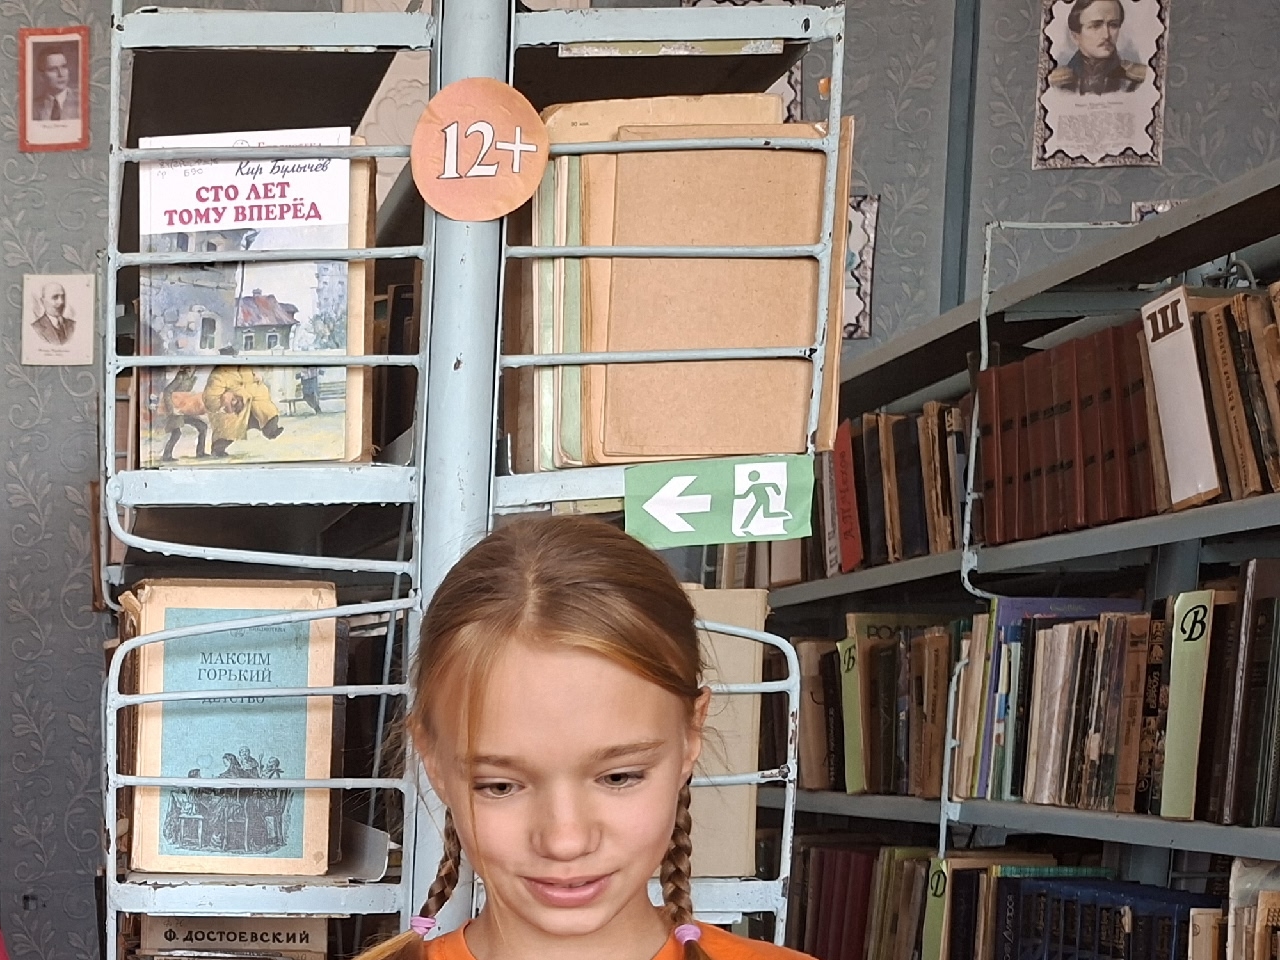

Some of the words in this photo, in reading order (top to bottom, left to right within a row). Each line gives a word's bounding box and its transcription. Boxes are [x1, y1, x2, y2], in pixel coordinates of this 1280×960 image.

[438, 120, 537, 181] 12+
[235, 160, 263, 180] Кир
[269, 157, 330, 179] Булычёв
[195, 185, 239, 203] СТО
[245, 182, 291, 201] ЛЕТ
[164, 206, 228, 226] ТОМУ
[233, 198, 322, 223] ВПЕРЁД
[1146, 299, 1185, 344] Ш
[1180, 603, 1209, 643] В
[199, 651, 272, 666] МАКСИМ
[197, 667, 272, 683] ГОРЬКИЙ
[163, 928, 180, 945] Ф.
[182, 929, 311, 945] ДОСТОЕВСКИЙ
